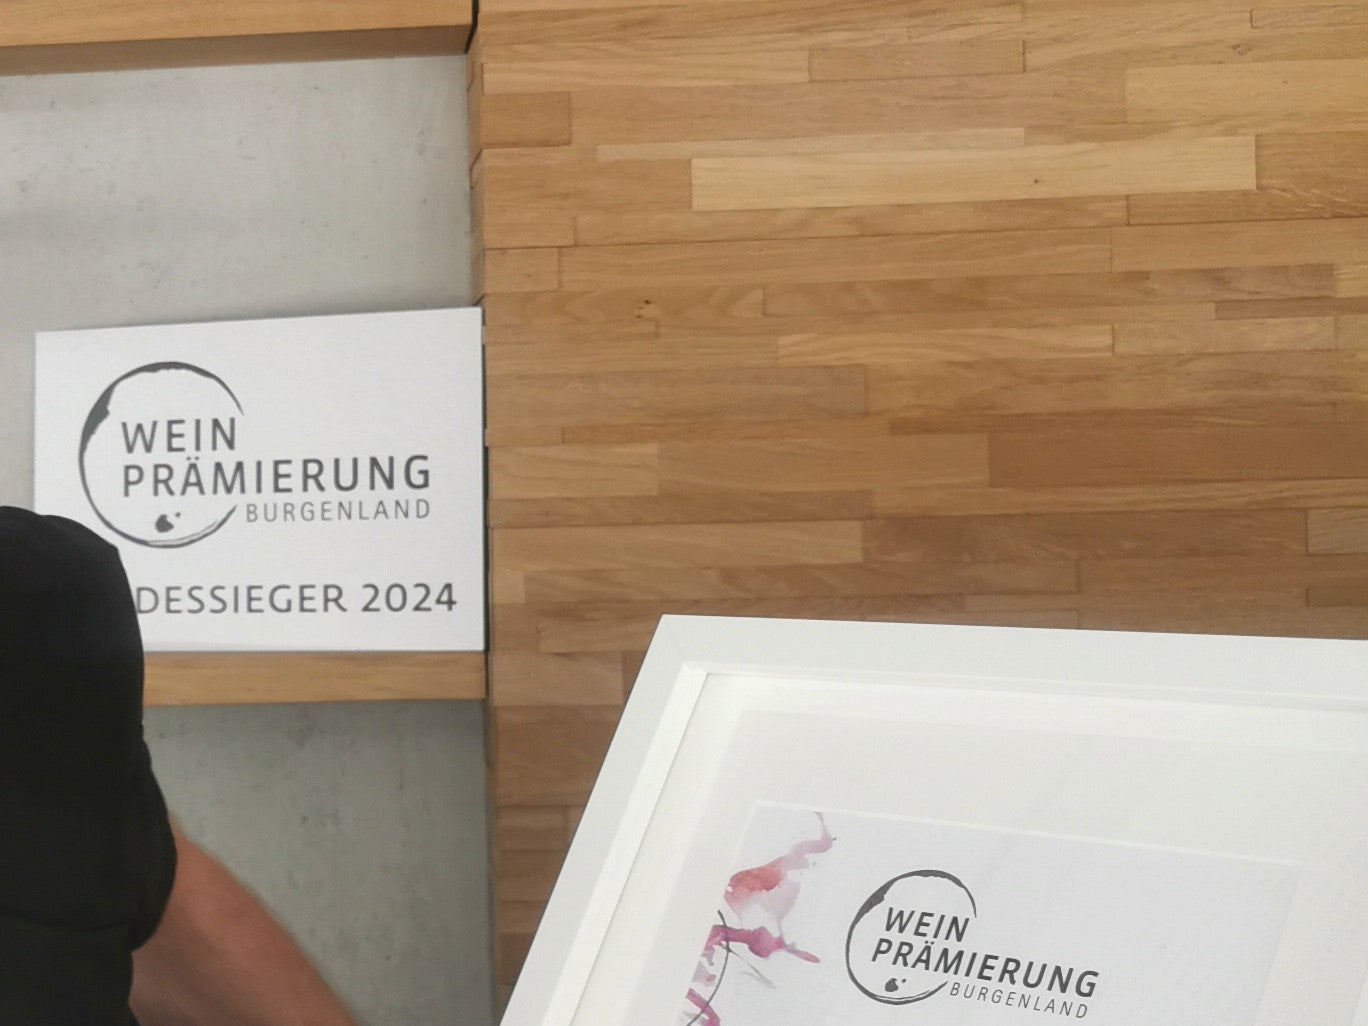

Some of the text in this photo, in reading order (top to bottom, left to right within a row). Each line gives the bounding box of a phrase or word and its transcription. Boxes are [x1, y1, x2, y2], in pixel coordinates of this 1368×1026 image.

[121, 417, 237, 453] WEIN
[122, 454, 431, 497] PRÄMIERUNG
[245, 499, 431, 523] BURGENLAND
[136, 583, 458, 614] DESSIEGER 2024
[884, 907, 970, 942] WEIN
[871, 938, 1100, 998] PRÄMIERUNG
[949, 981, 1089, 1019] BURGENLAND
